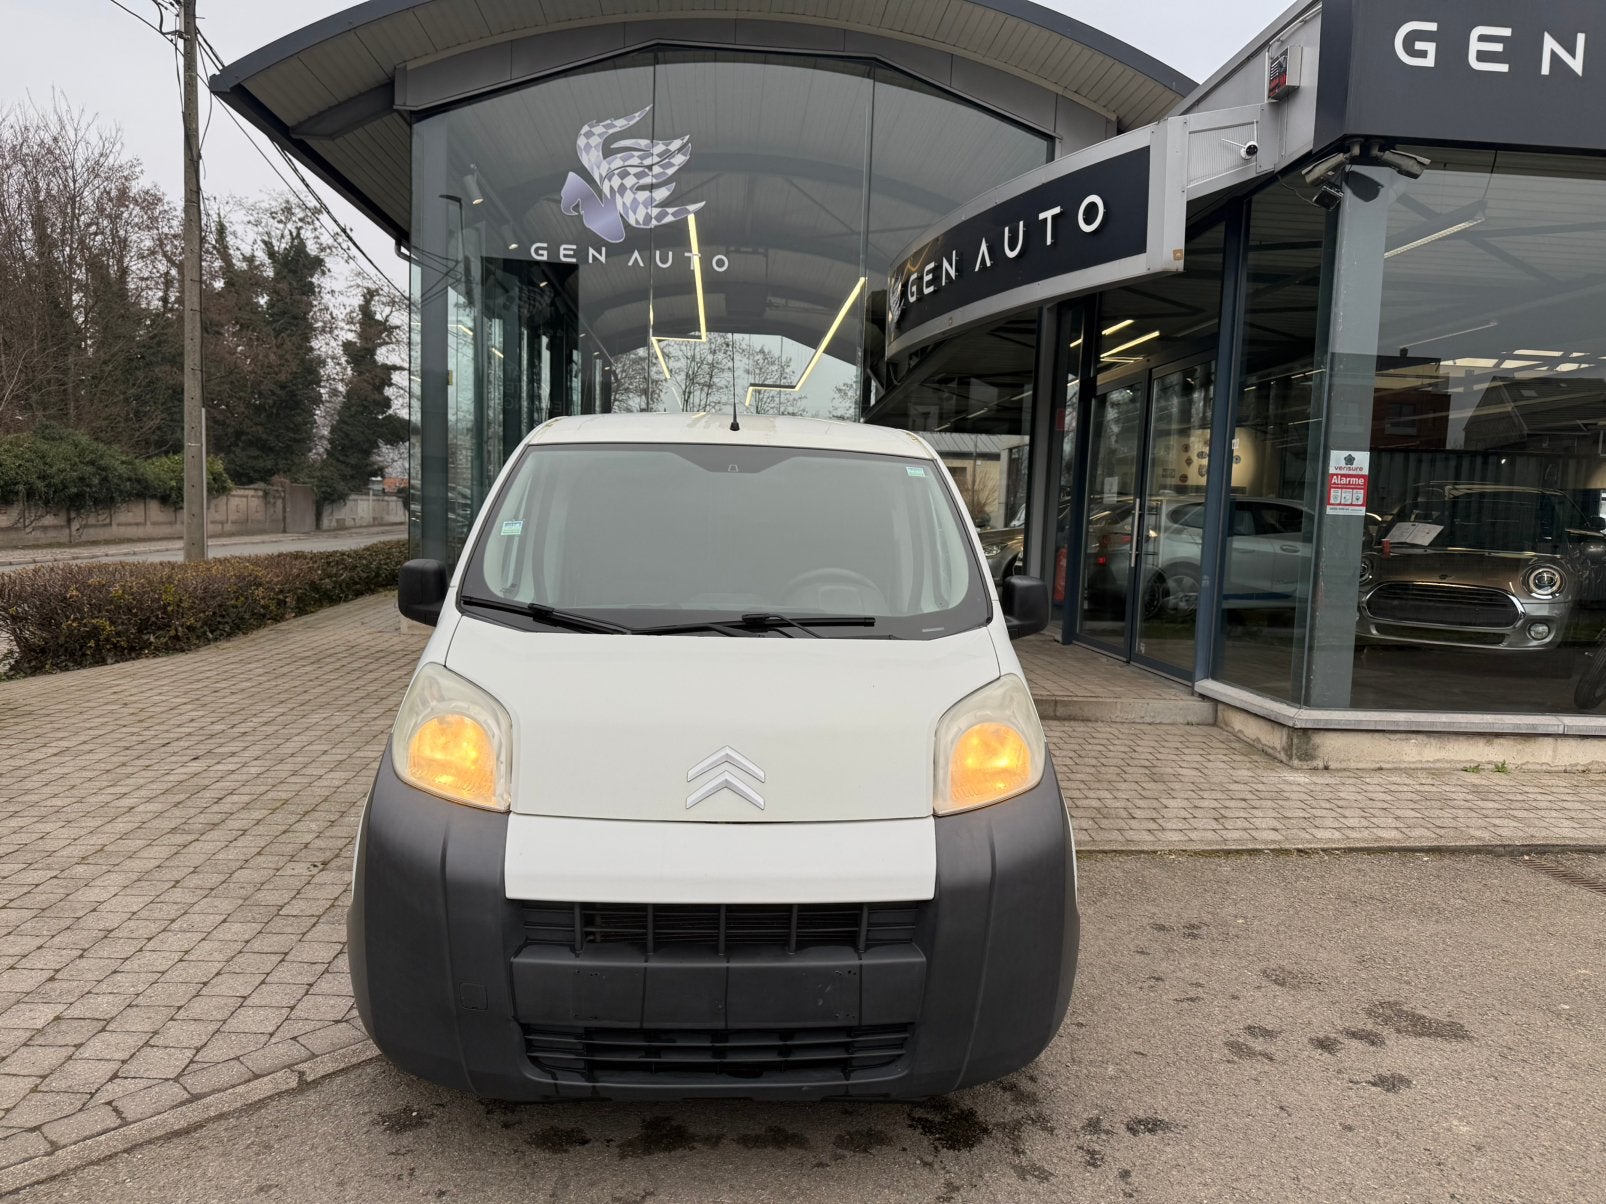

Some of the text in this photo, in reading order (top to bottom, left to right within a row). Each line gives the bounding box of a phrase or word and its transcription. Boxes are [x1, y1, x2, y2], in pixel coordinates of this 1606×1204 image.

[1394, 20, 1586, 77] GEN
[530, 242, 729, 272] GEN AUTO
[907, 194, 1105, 303] GEN AUTO
[1331, 475, 1365, 484] Alarme
